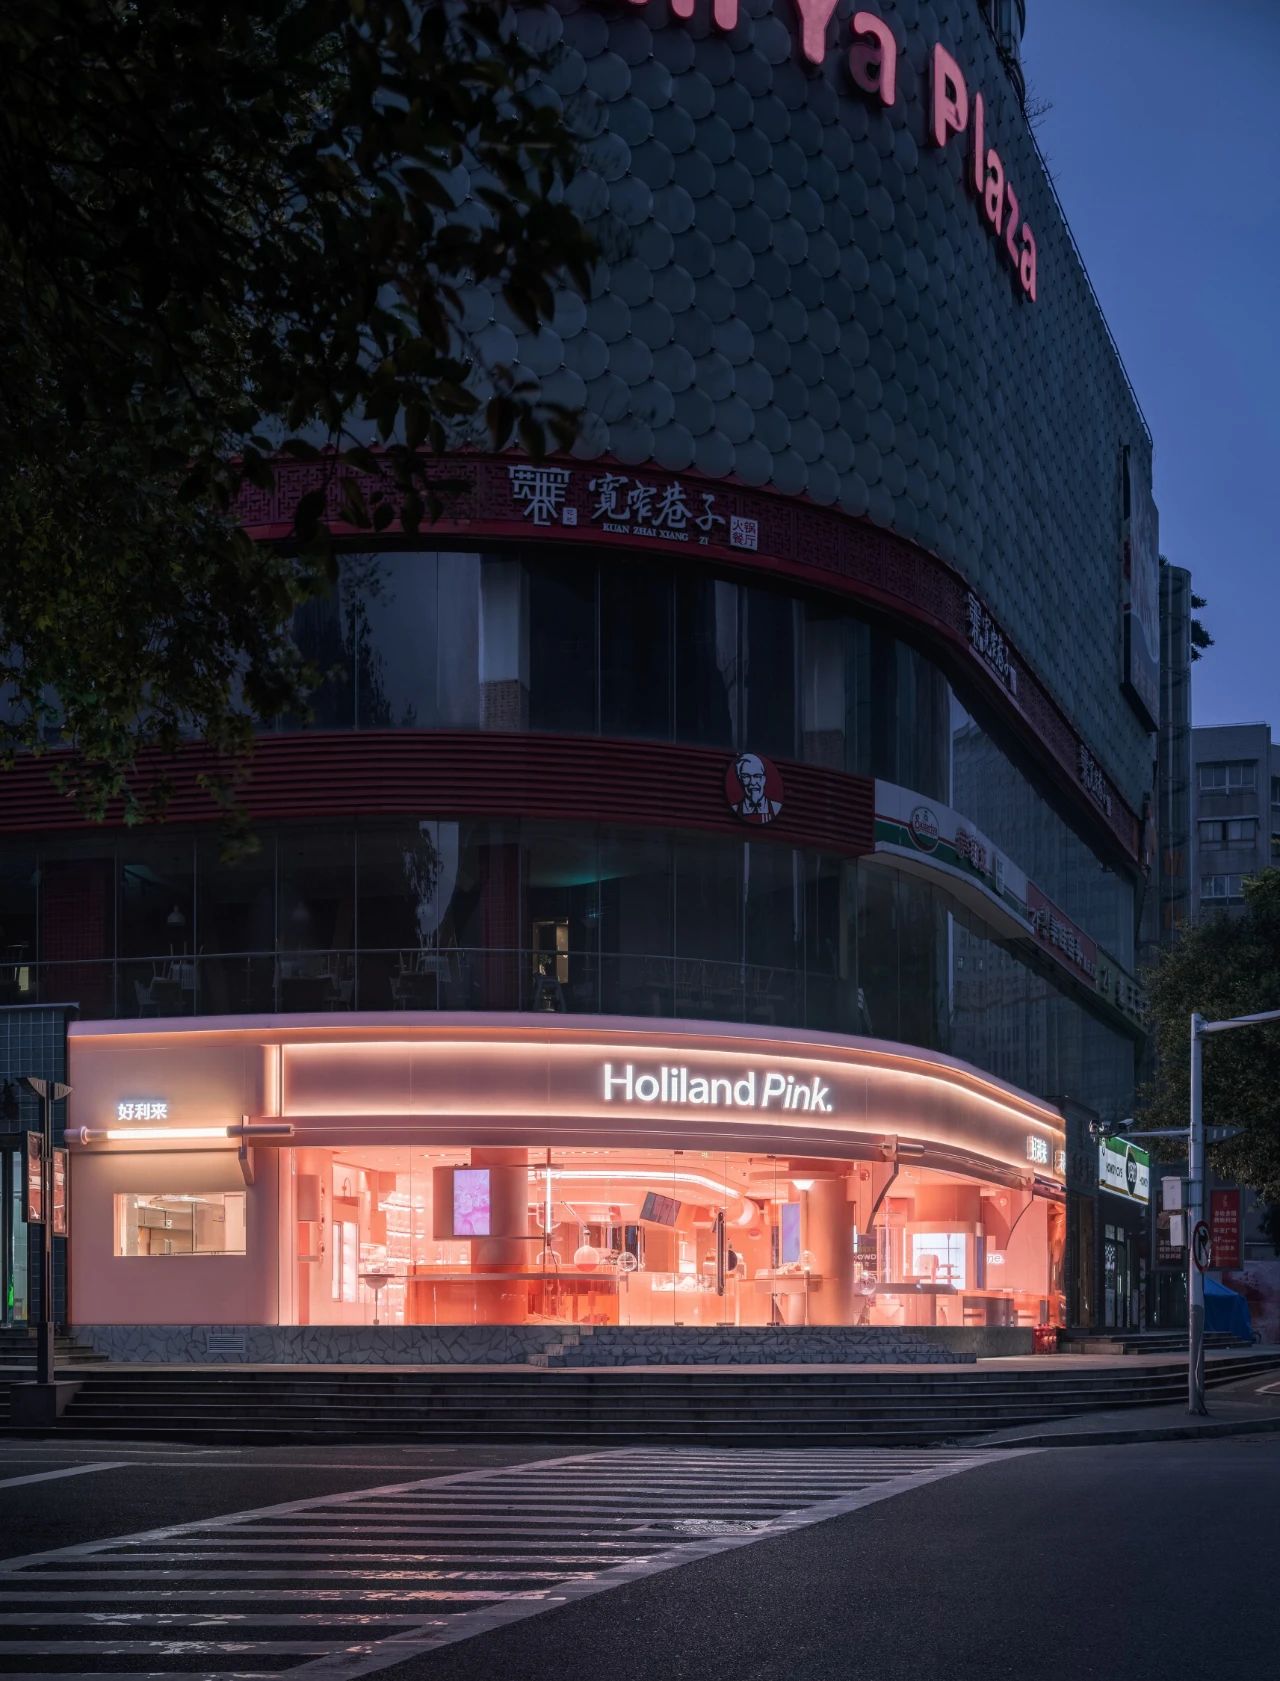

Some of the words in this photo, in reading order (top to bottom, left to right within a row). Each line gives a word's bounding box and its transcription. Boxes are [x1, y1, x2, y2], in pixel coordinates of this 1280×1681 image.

[929, 40, 1039, 304] Plaza
[602, 522, 630, 534] KUAN
[659, 529, 689, 542] XIANG
[603, 1063, 756, 1107] Holiland
[760, 1072, 834, 1112] Pink.
[117, 1103, 168, 1121] 好利来
